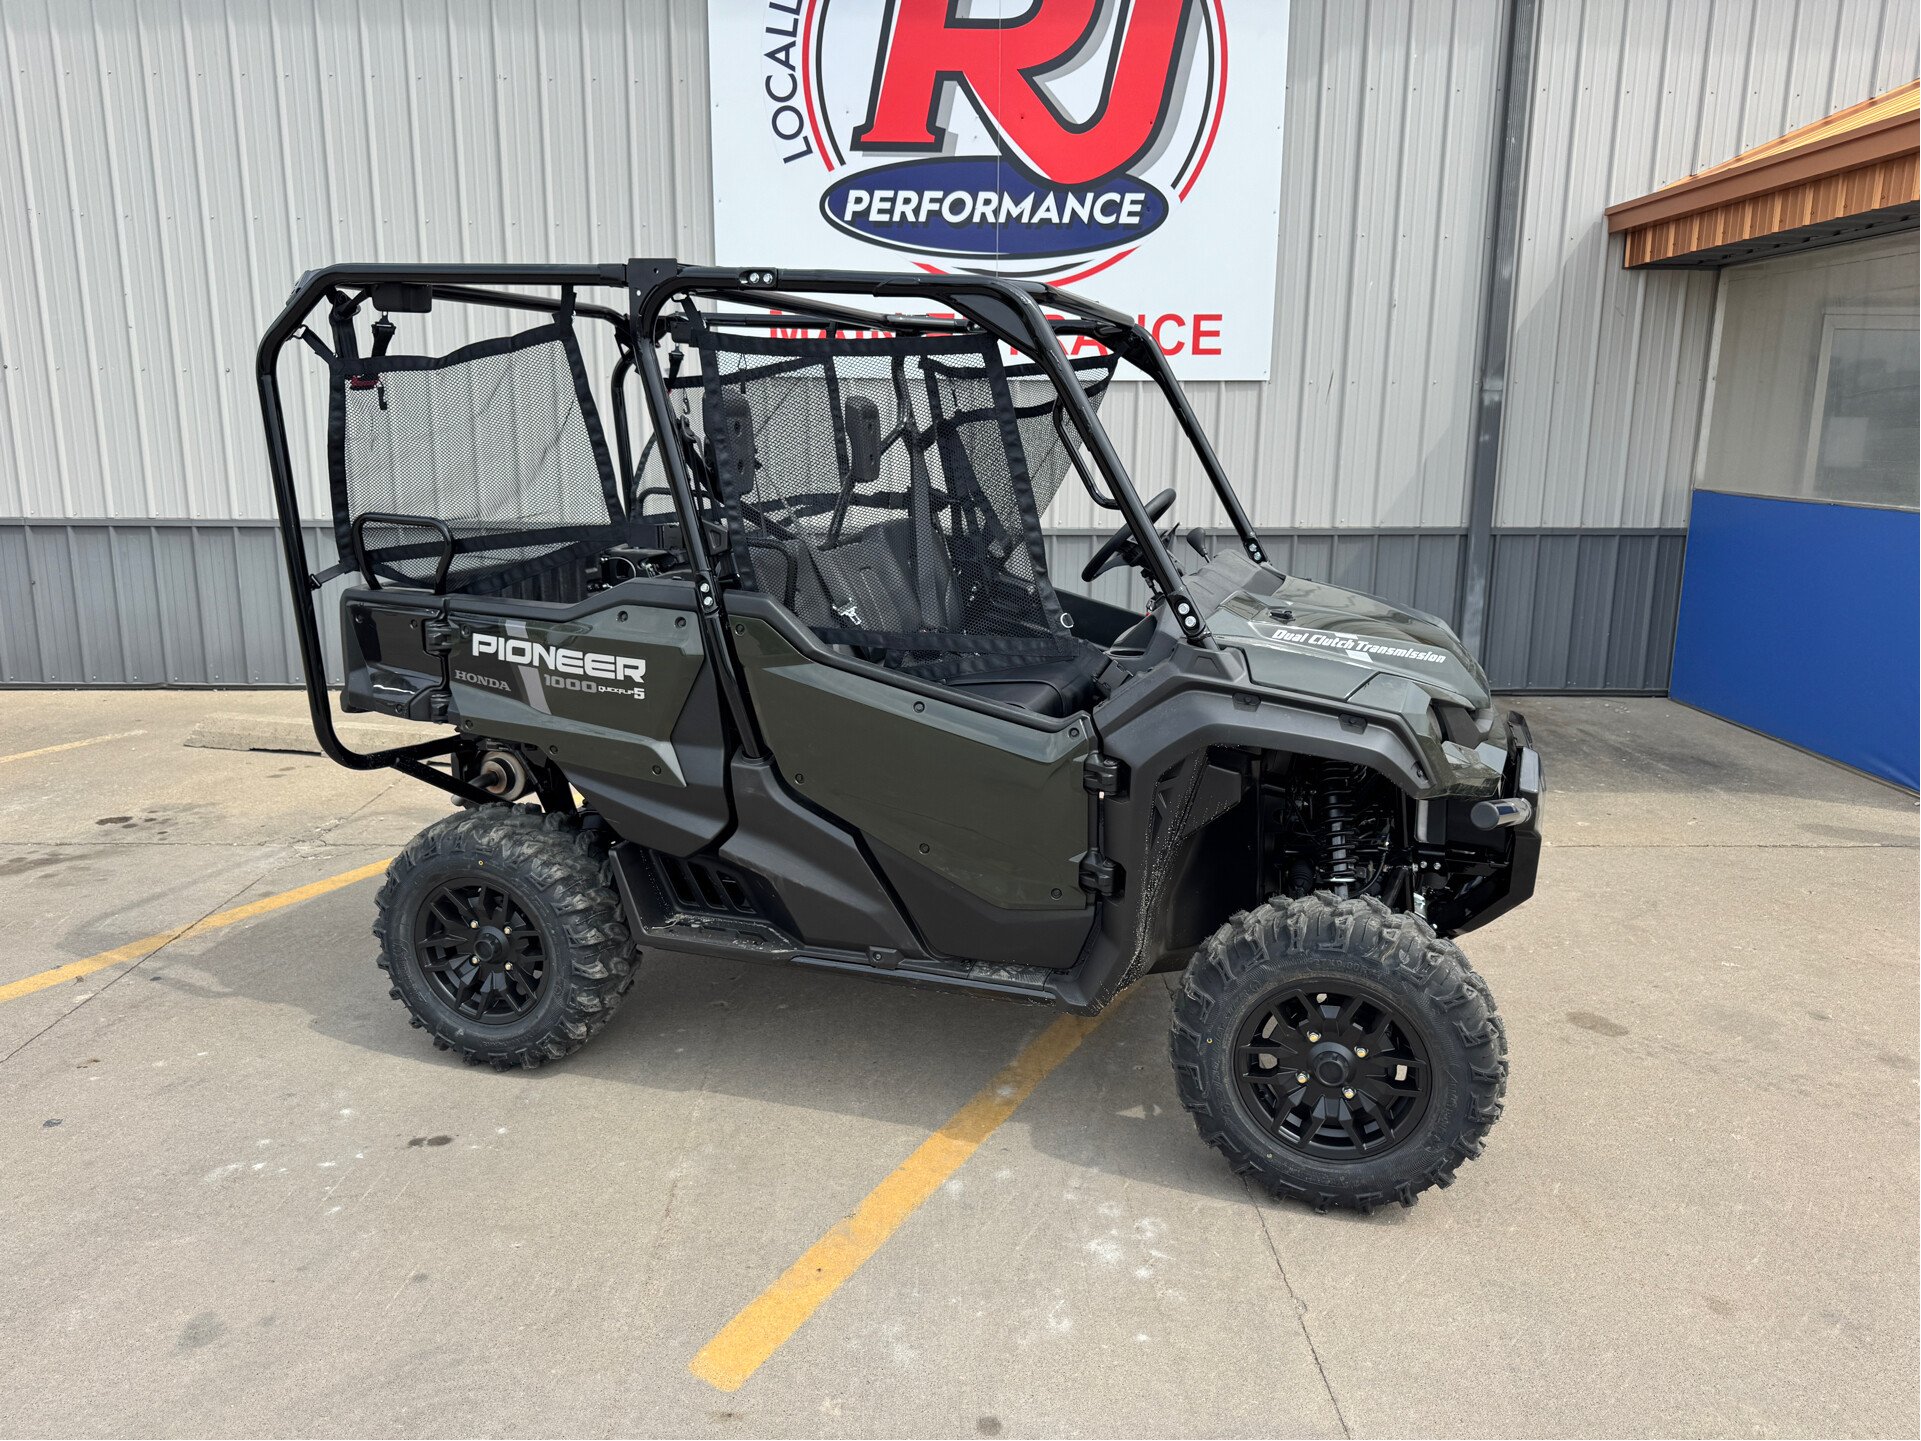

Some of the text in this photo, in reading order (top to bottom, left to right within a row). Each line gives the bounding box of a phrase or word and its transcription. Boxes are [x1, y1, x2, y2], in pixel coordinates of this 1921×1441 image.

[844, 189, 1146, 225] PERFORMANCE
[472, 633, 646, 683] PIONEER
[1272, 629, 1446, 663] Dual Clutch Transmission
[455, 670, 511, 692] HONDA
[544, 674, 597, 693] 1000
